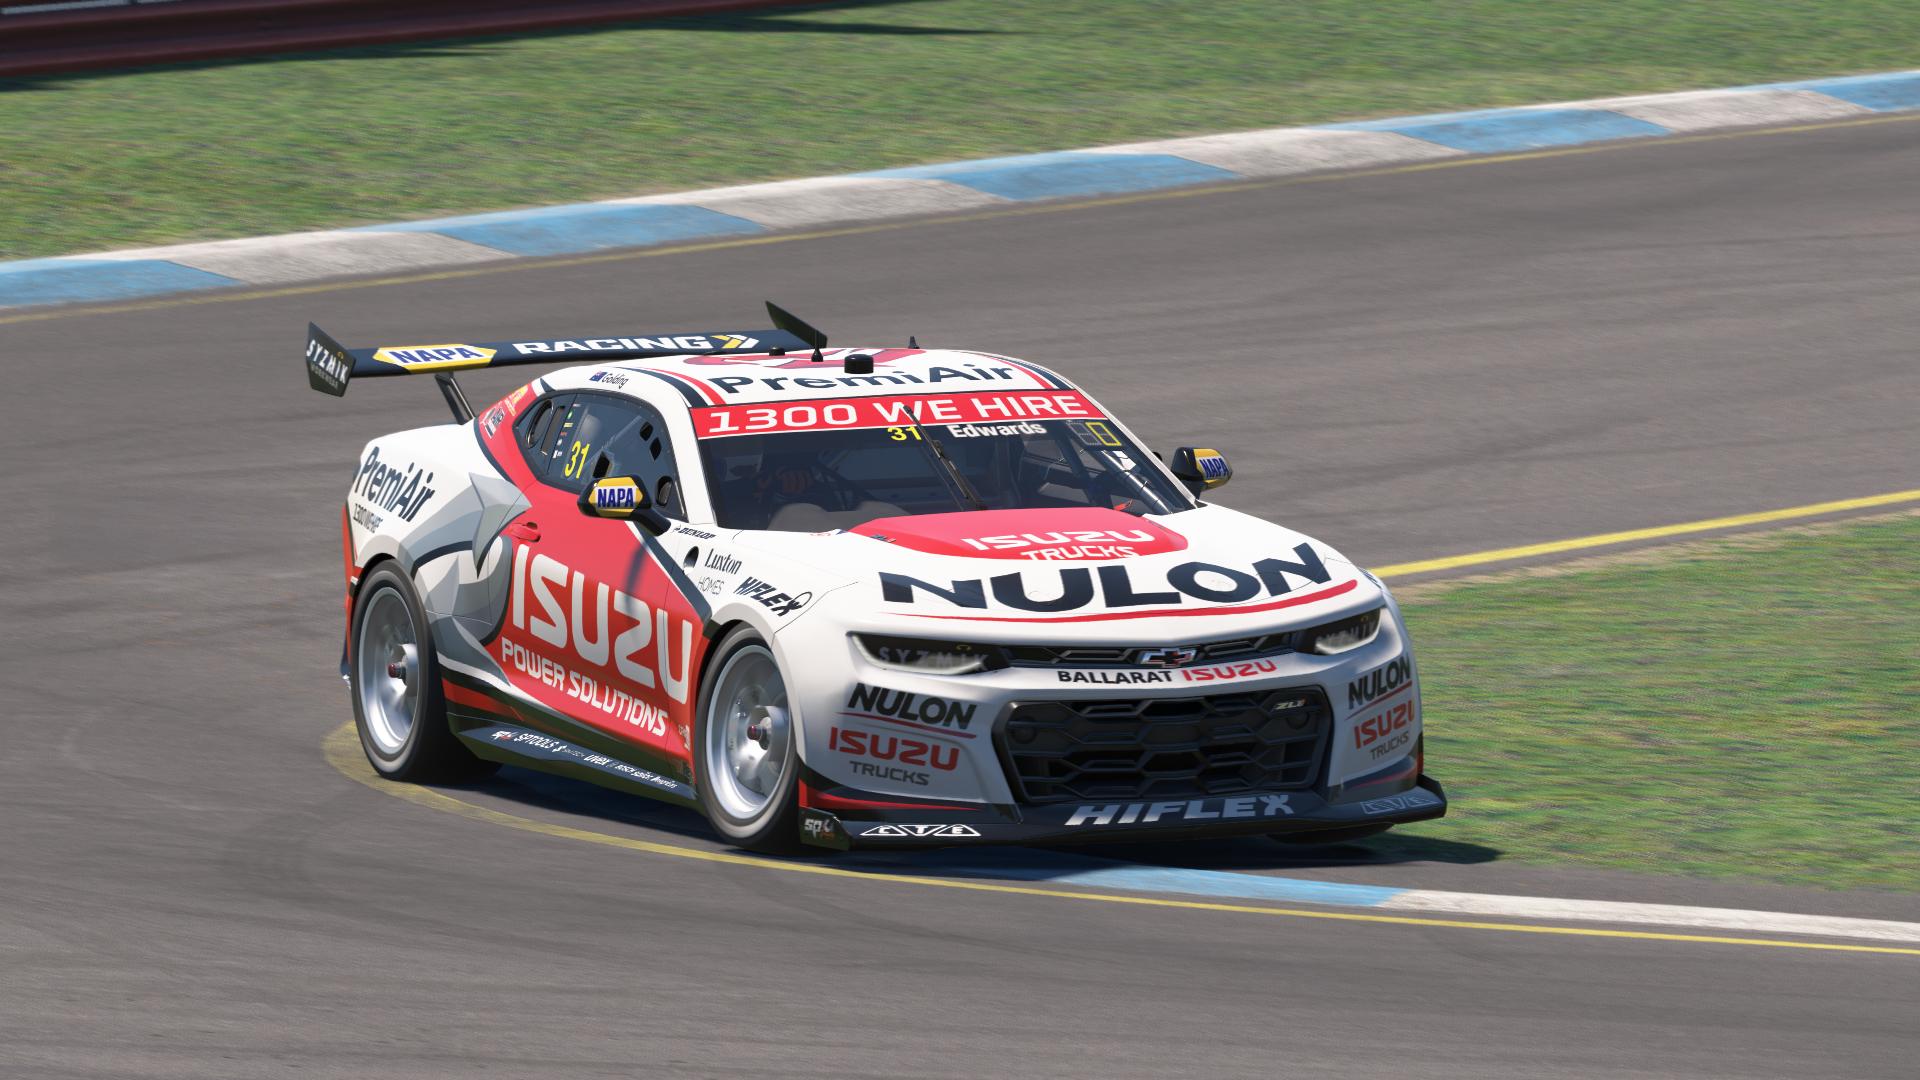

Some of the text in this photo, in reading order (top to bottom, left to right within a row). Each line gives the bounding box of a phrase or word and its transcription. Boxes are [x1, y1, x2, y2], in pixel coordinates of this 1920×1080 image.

[388, 346, 482, 364] NAPA
[512, 334, 710, 355] RACING
[602, 372, 629, 389] Golding
[707, 363, 1014, 394] PremiAir
[709, 395, 1089, 433] 1300 WE HIRE
[887, 424, 922, 441] 31
[946, 422, 1048, 439] Edwards
[564, 440, 591, 478] 31
[1199, 456, 1231, 480] NAPA
[354, 446, 436, 523] PremiAir
[597, 487, 634, 508] NAPA
[961, 530, 1155, 551] ISUZU
[1020, 545, 1141, 561] TRUCKS
[704, 548, 742, 575] Luxton
[698, 576, 725, 596] HOMES
[878, 542, 1332, 613] NULON
[733, 576, 806, 617] HIFLEX
[513, 543, 693, 705] ISUZU
[1057, 659, 1279, 685] BALLARAT ISUZU
[1348, 655, 1411, 710] NULON
[501, 636, 669, 737] POWER SOLUTIONS
[847, 682, 977, 730] NULON
[829, 726, 961, 771] ISUZU
[1369, 731, 1409, 760] TRUCKS
[850, 760, 930, 786] TRUCKS
[1065, 794, 1295, 826] HIFLEX
